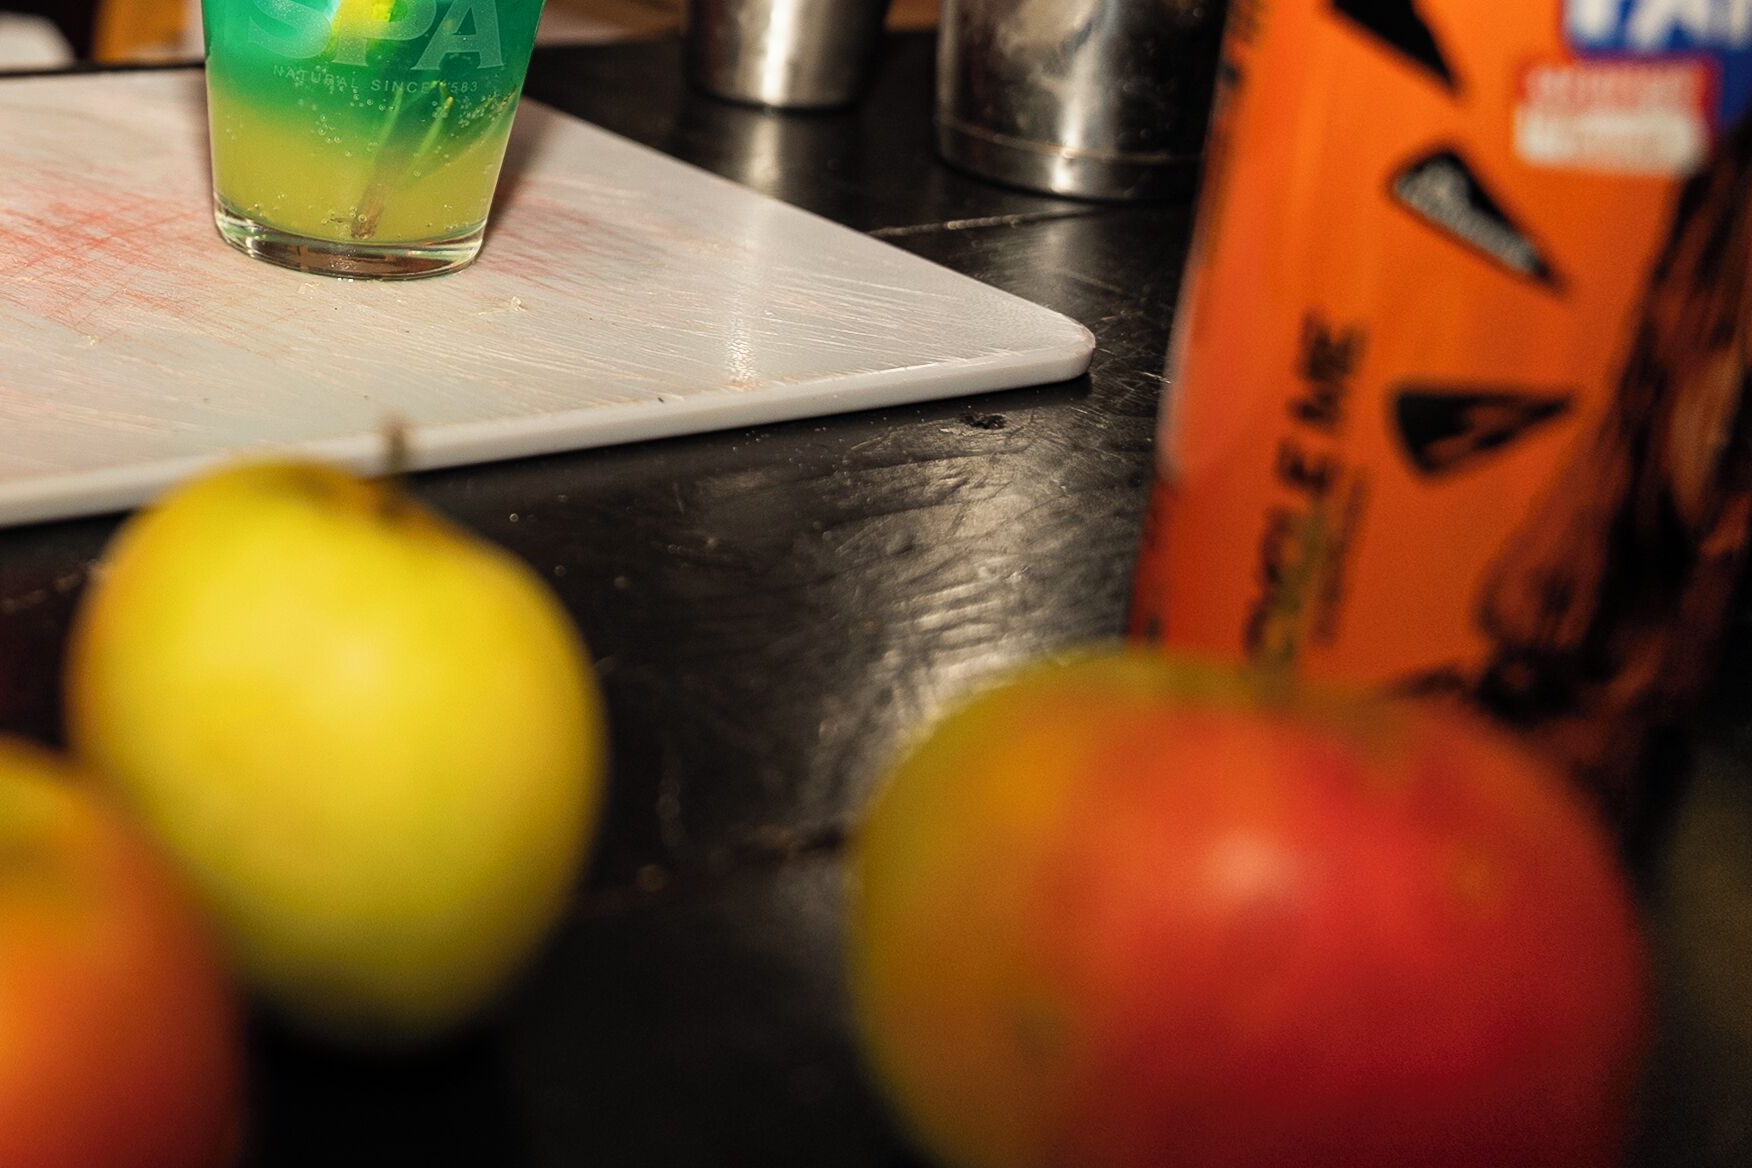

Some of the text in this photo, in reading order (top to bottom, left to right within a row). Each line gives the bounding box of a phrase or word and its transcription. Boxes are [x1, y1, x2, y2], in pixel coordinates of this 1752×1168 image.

[273, 64, 480, 95] NATURAL SINCE 583
